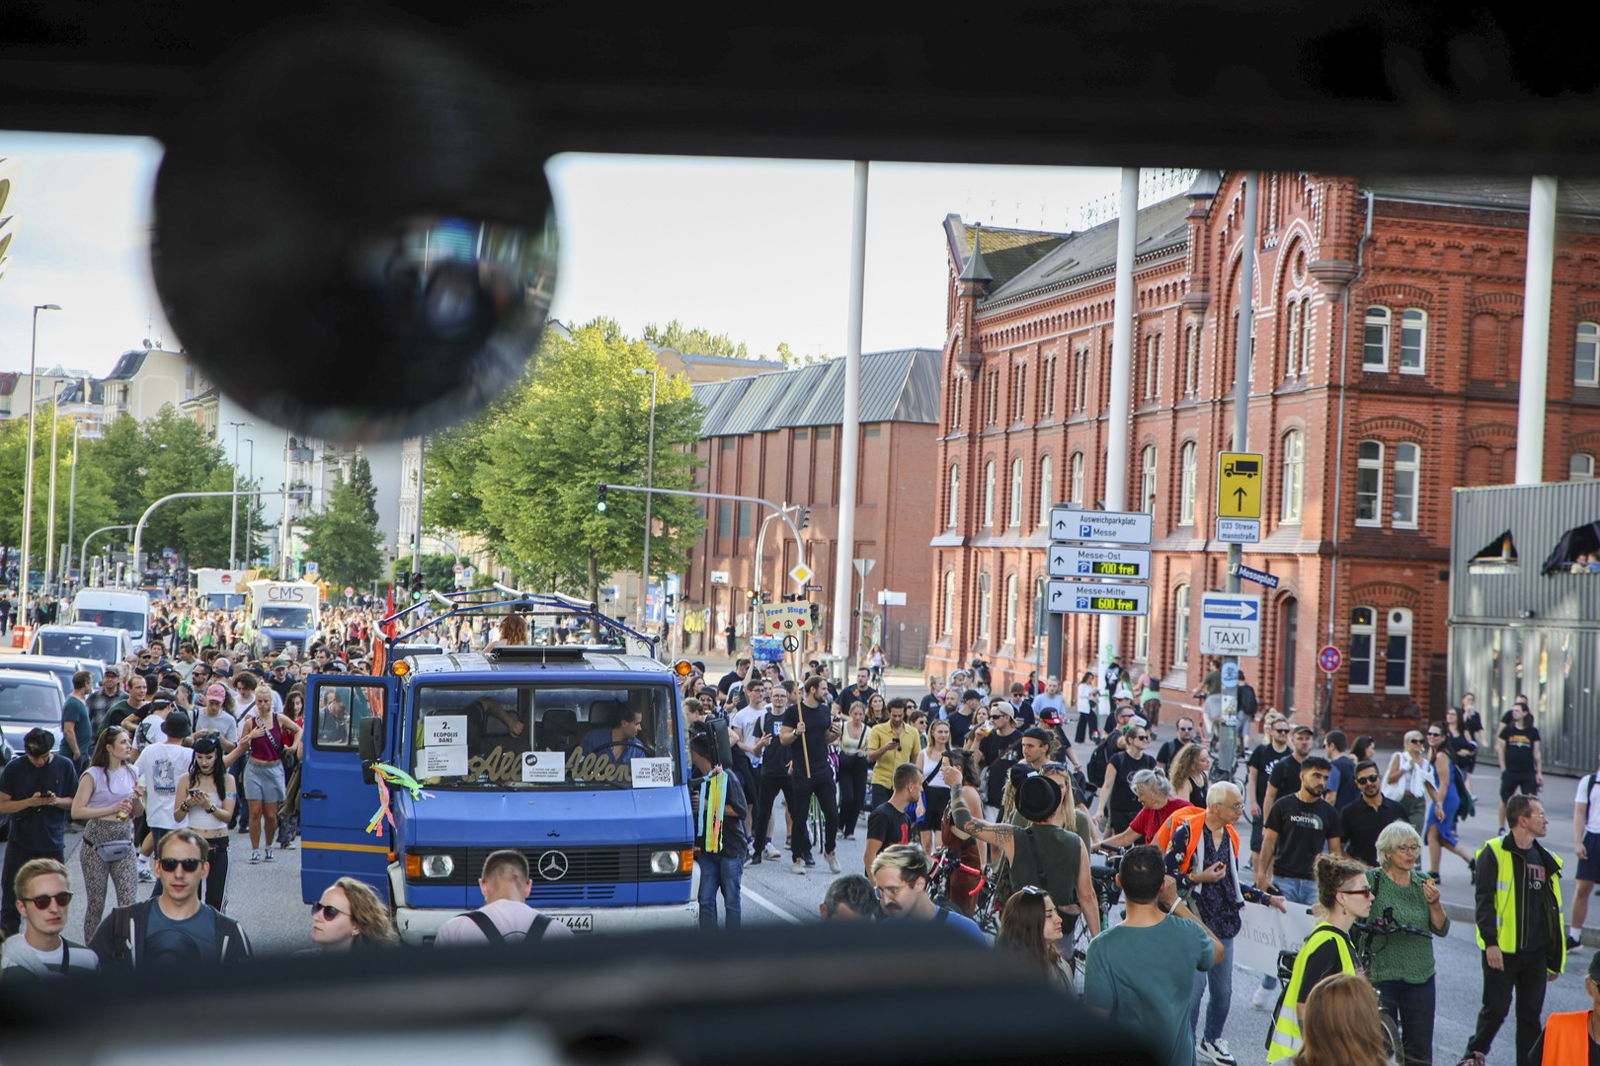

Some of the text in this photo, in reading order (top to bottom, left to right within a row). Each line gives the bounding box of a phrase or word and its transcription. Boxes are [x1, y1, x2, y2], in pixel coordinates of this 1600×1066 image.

[1080, 515, 1136, 526] Ausweichparkplatz
[1093, 528, 1117, 537] Messe
[1078, 551, 1121, 560] Messe-Ost
[1100, 562, 1135, 575] 700 frei
[268, 586, 304, 602] CMS
[1076, 586, 1126, 596] Messe-Mitte
[1098, 599, 1133, 611] 600 frei
[765, 608, 783, 617] Free
[1214, 631, 1244, 645] TAXI
[441, 721, 450, 730] 2.
[566, 917, 590, 928] 444
